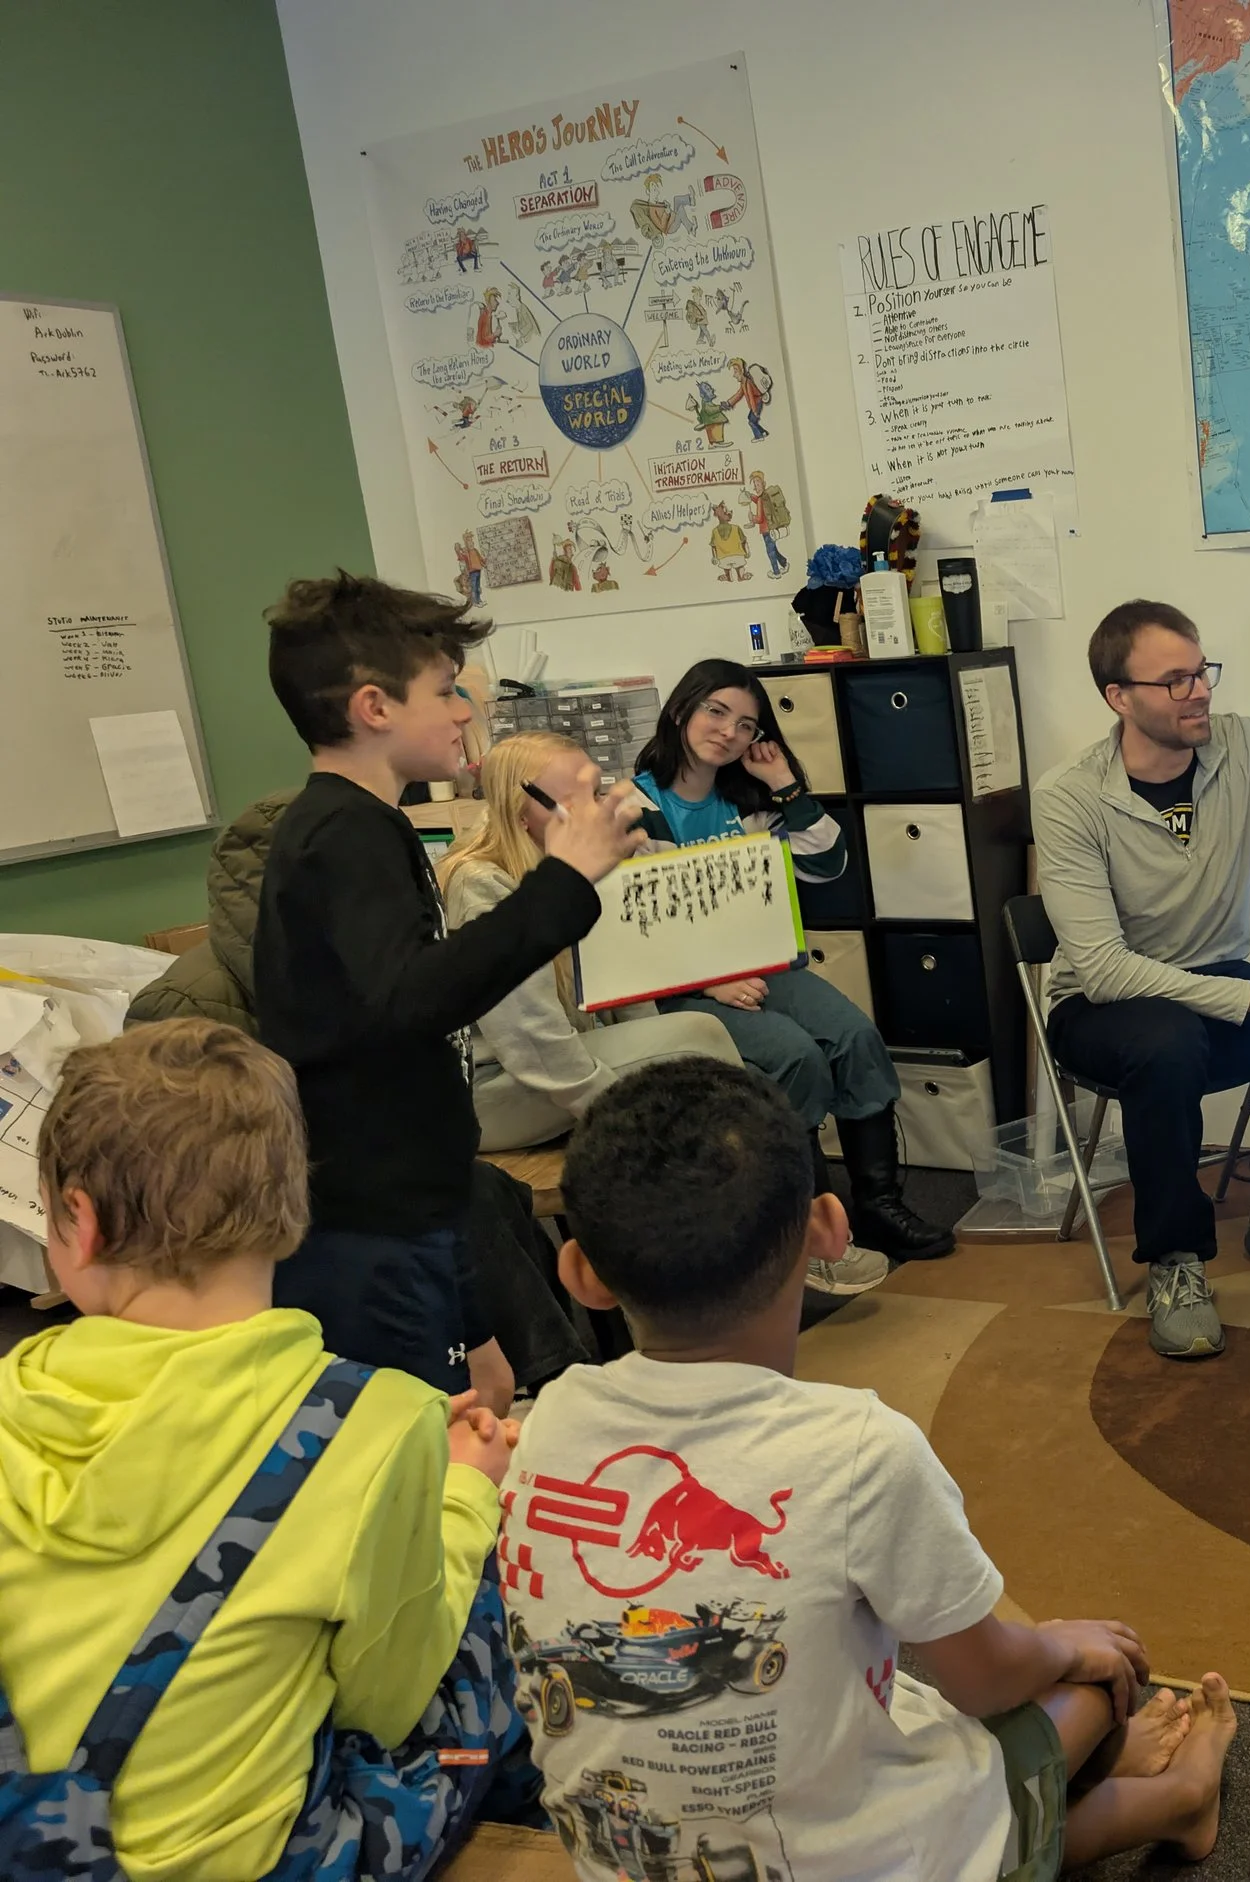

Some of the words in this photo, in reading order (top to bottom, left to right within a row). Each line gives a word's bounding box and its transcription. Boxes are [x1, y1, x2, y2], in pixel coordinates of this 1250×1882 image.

[463, 154, 483, 173] THE
[481, 125, 547, 169] HERO'S
[551, 100, 640, 151] JOURNEY
[645, 148, 679, 161] Adventure
[539, 170, 558, 189] ACT
[563, 165, 573, 184] 1
[429, 199, 454, 218] Having
[453, 190, 484, 212] Changed
[519, 185, 594, 213] SEPARATION
[713, 176, 746, 227] ADVENTURE
[657, 257, 694, 276] Entering
[695, 252, 709, 267] the
[857, 226, 916, 294] RULES
[921, 225, 943, 282] OF
[868, 289, 922, 316] Position
[970, 281, 986, 293] you
[986, 280, 1000, 289] can
[1002, 277, 1012, 287] be
[557, 329, 612, 350] ORDINARY
[562, 352, 611, 373] WORLD
[857, 354, 870, 365] 2.
[898, 351, 919, 366] bring
[920, 345, 970, 363] distractions
[971, 344, 988, 356] into
[990, 342, 1005, 353] the
[1008, 339, 1030, 350] circle
[658, 361, 683, 375] Meeting
[698, 356, 721, 367] Mentor
[563, 384, 632, 411] SPECIAL
[569, 409, 628, 430] WORLD
[880, 406, 910, 424] When
[912, 404, 921, 416] it
[922, 403, 928, 413] is
[513, 435, 520, 447] 3
[695, 437, 705, 451] 2
[477, 463, 495, 477] THE
[499, 457, 544, 474] RETURN
[654, 457, 706, 475] INITIATION
[655, 468, 739, 488] TRANSFORMATION
[485, 496, 504, 510] Final
[569, 494, 590, 507] Road
[605, 490, 626, 503] Trials
[651, 504, 706, 522] Allies/Helpers
[620, 1668, 688, 1685] ORACLE
[699, 1718, 741, 1728] MODEL
[743, 1710, 778, 1721] NAME
[657, 1728, 709, 1741] ORACLE
[714, 1726, 741, 1739] RED
[745, 1719, 778, 1735] BULL
[671, 1742, 726, 1754] RACING
[621, 1755, 645, 1768] RED
[647, 1761, 677, 1774] BULL
[679, 1753, 777, 1776] POWERTRAINS
[721, 1766, 777, 1783] GEARBOX
[691, 1774, 777, 1797] EIGHT-SPEED
[681, 1802, 714, 1814] ESSO
